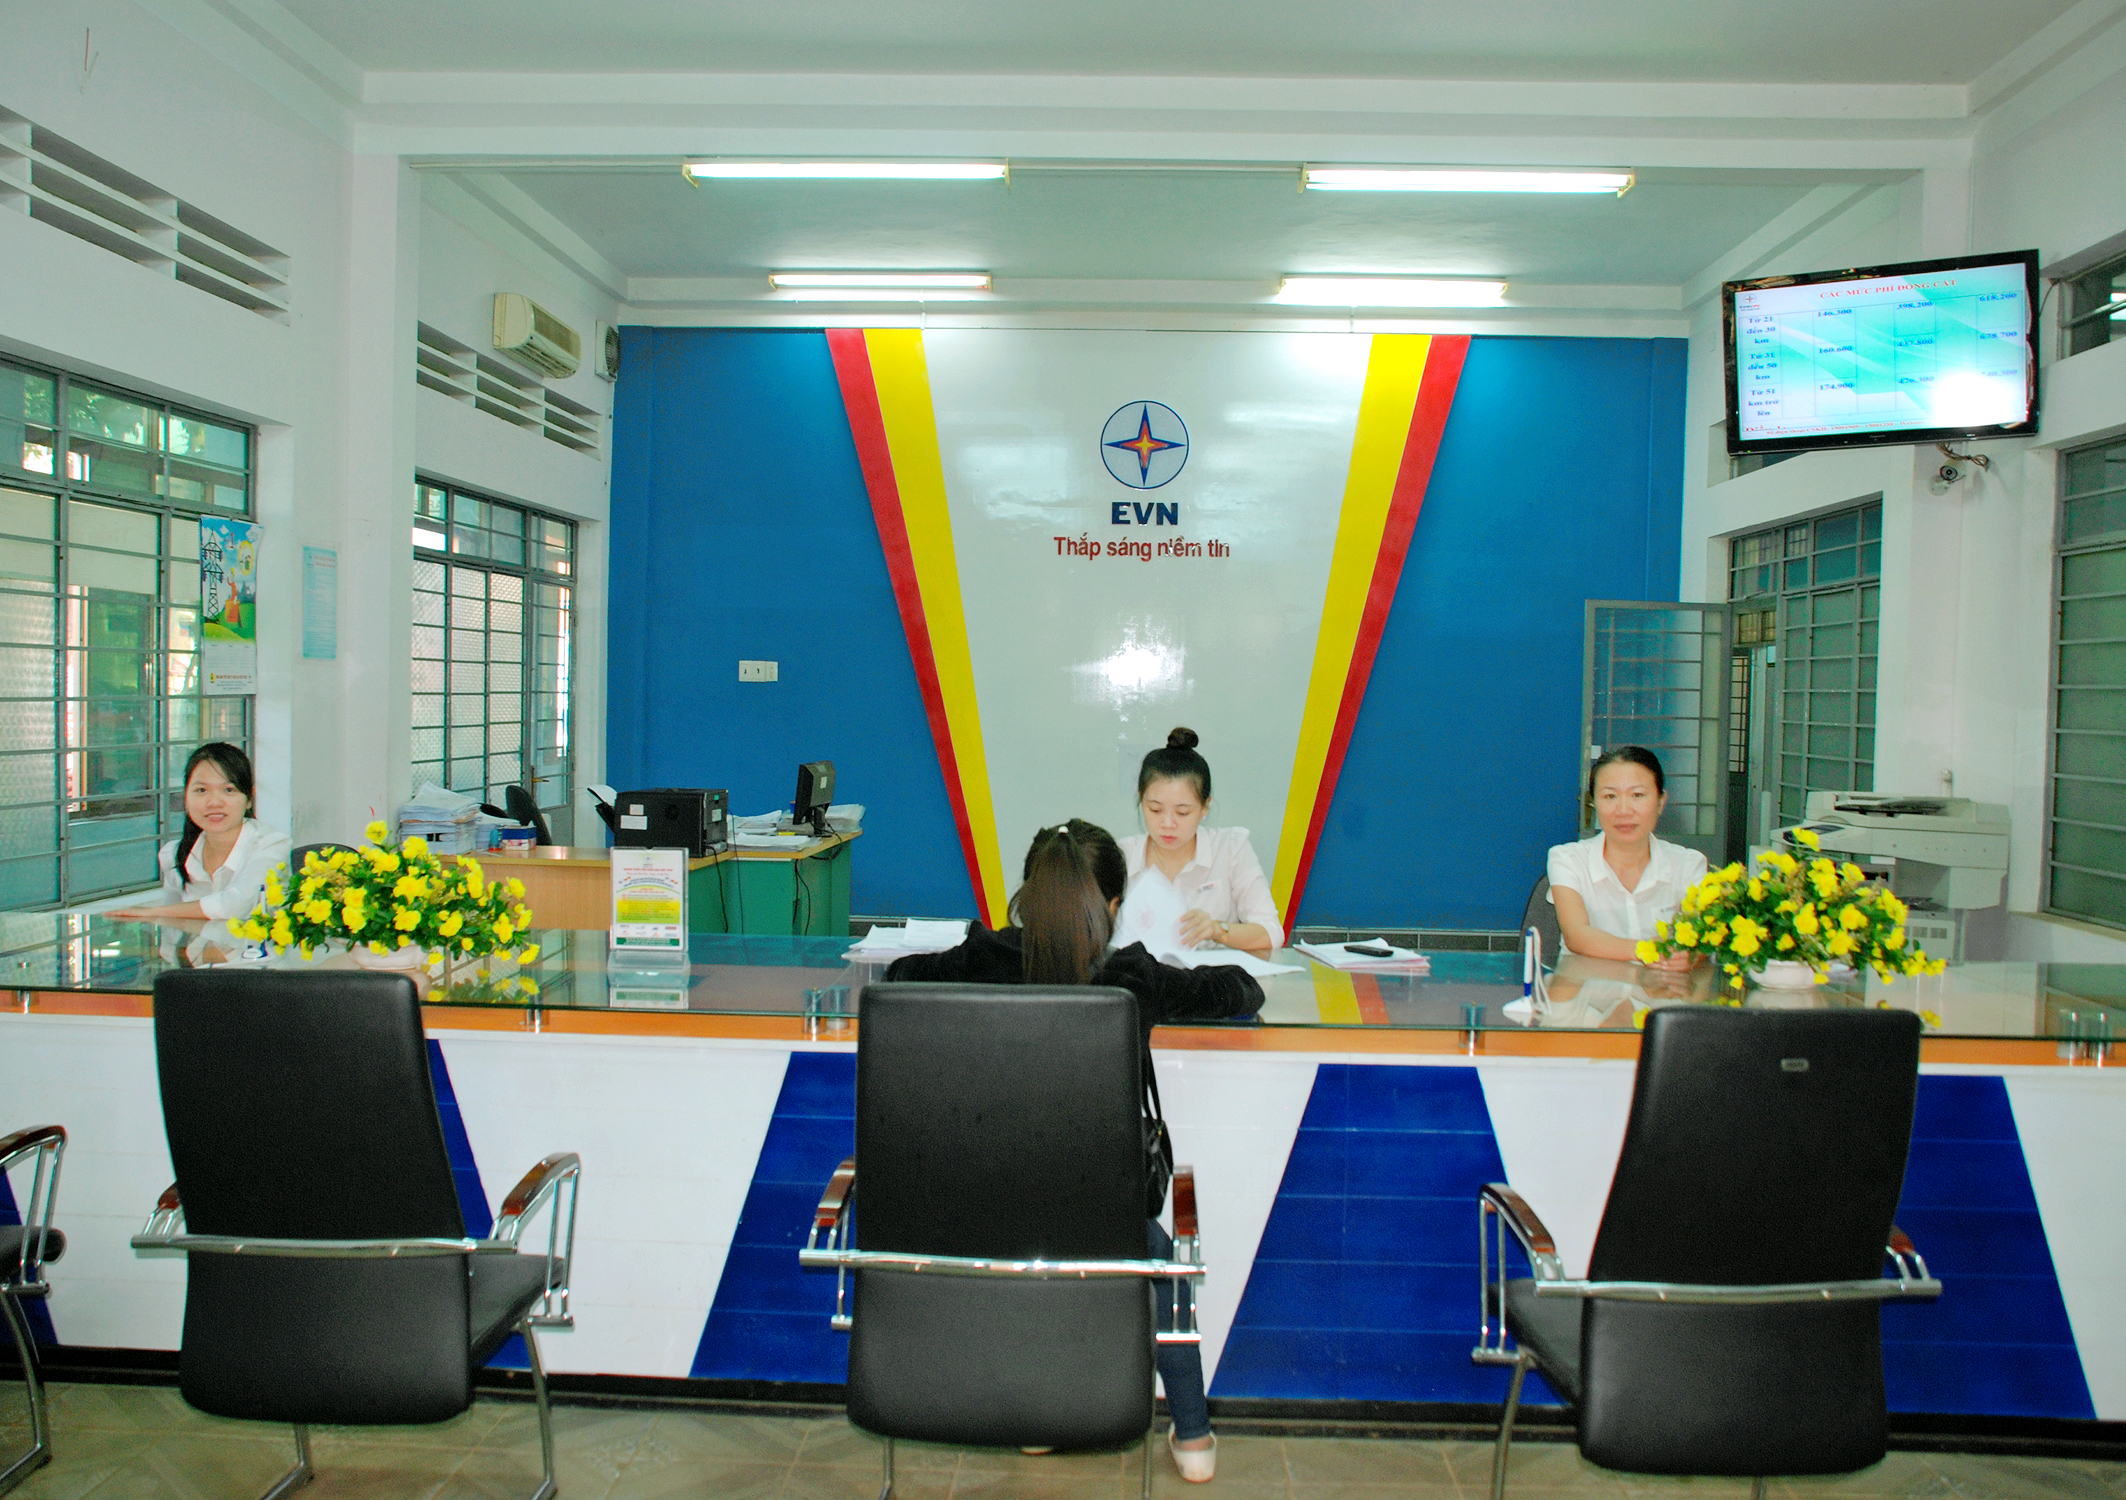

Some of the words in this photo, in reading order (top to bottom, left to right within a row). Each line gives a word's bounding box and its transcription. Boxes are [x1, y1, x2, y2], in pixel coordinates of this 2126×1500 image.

[1979, 291, 2018, 302] 618.200
[1979, 331, 2018, 340] 678.700
[1820, 382, 1855, 391] 174.900
[1111, 501, 1179, 526] EVN
[1054, 532, 1101, 561] Thắp
[1107, 537, 1152, 562] sáng
[1207, 539, 1230, 558] tin
